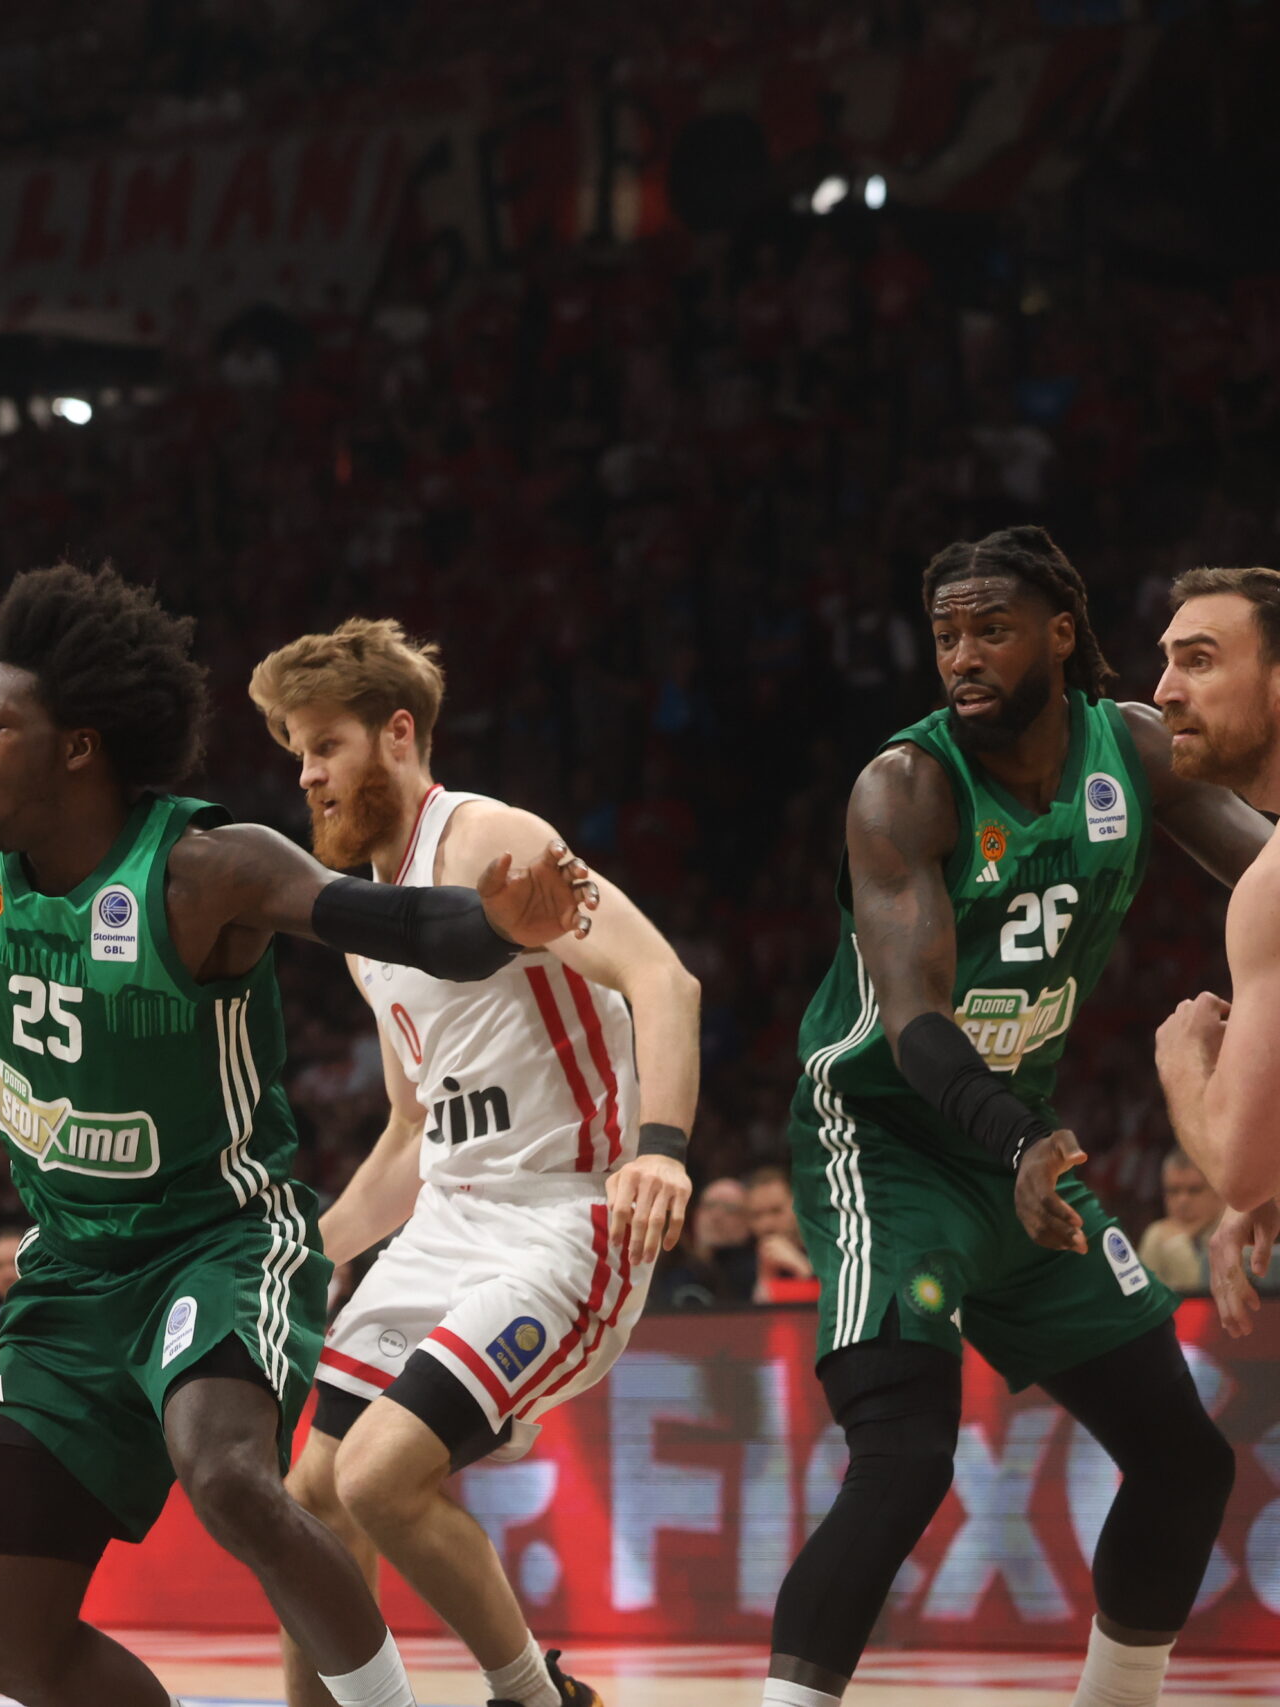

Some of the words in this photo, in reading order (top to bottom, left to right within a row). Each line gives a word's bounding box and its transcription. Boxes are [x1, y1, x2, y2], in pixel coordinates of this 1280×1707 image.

[1099, 825, 1118, 835] GBL
[1000, 884, 1079, 962] 26
[103, 945, 126, 955] GBL
[970, 997, 1017, 1015] pame
[8, 974, 83, 1063] 25
[3, 1068, 28, 1098] pame
